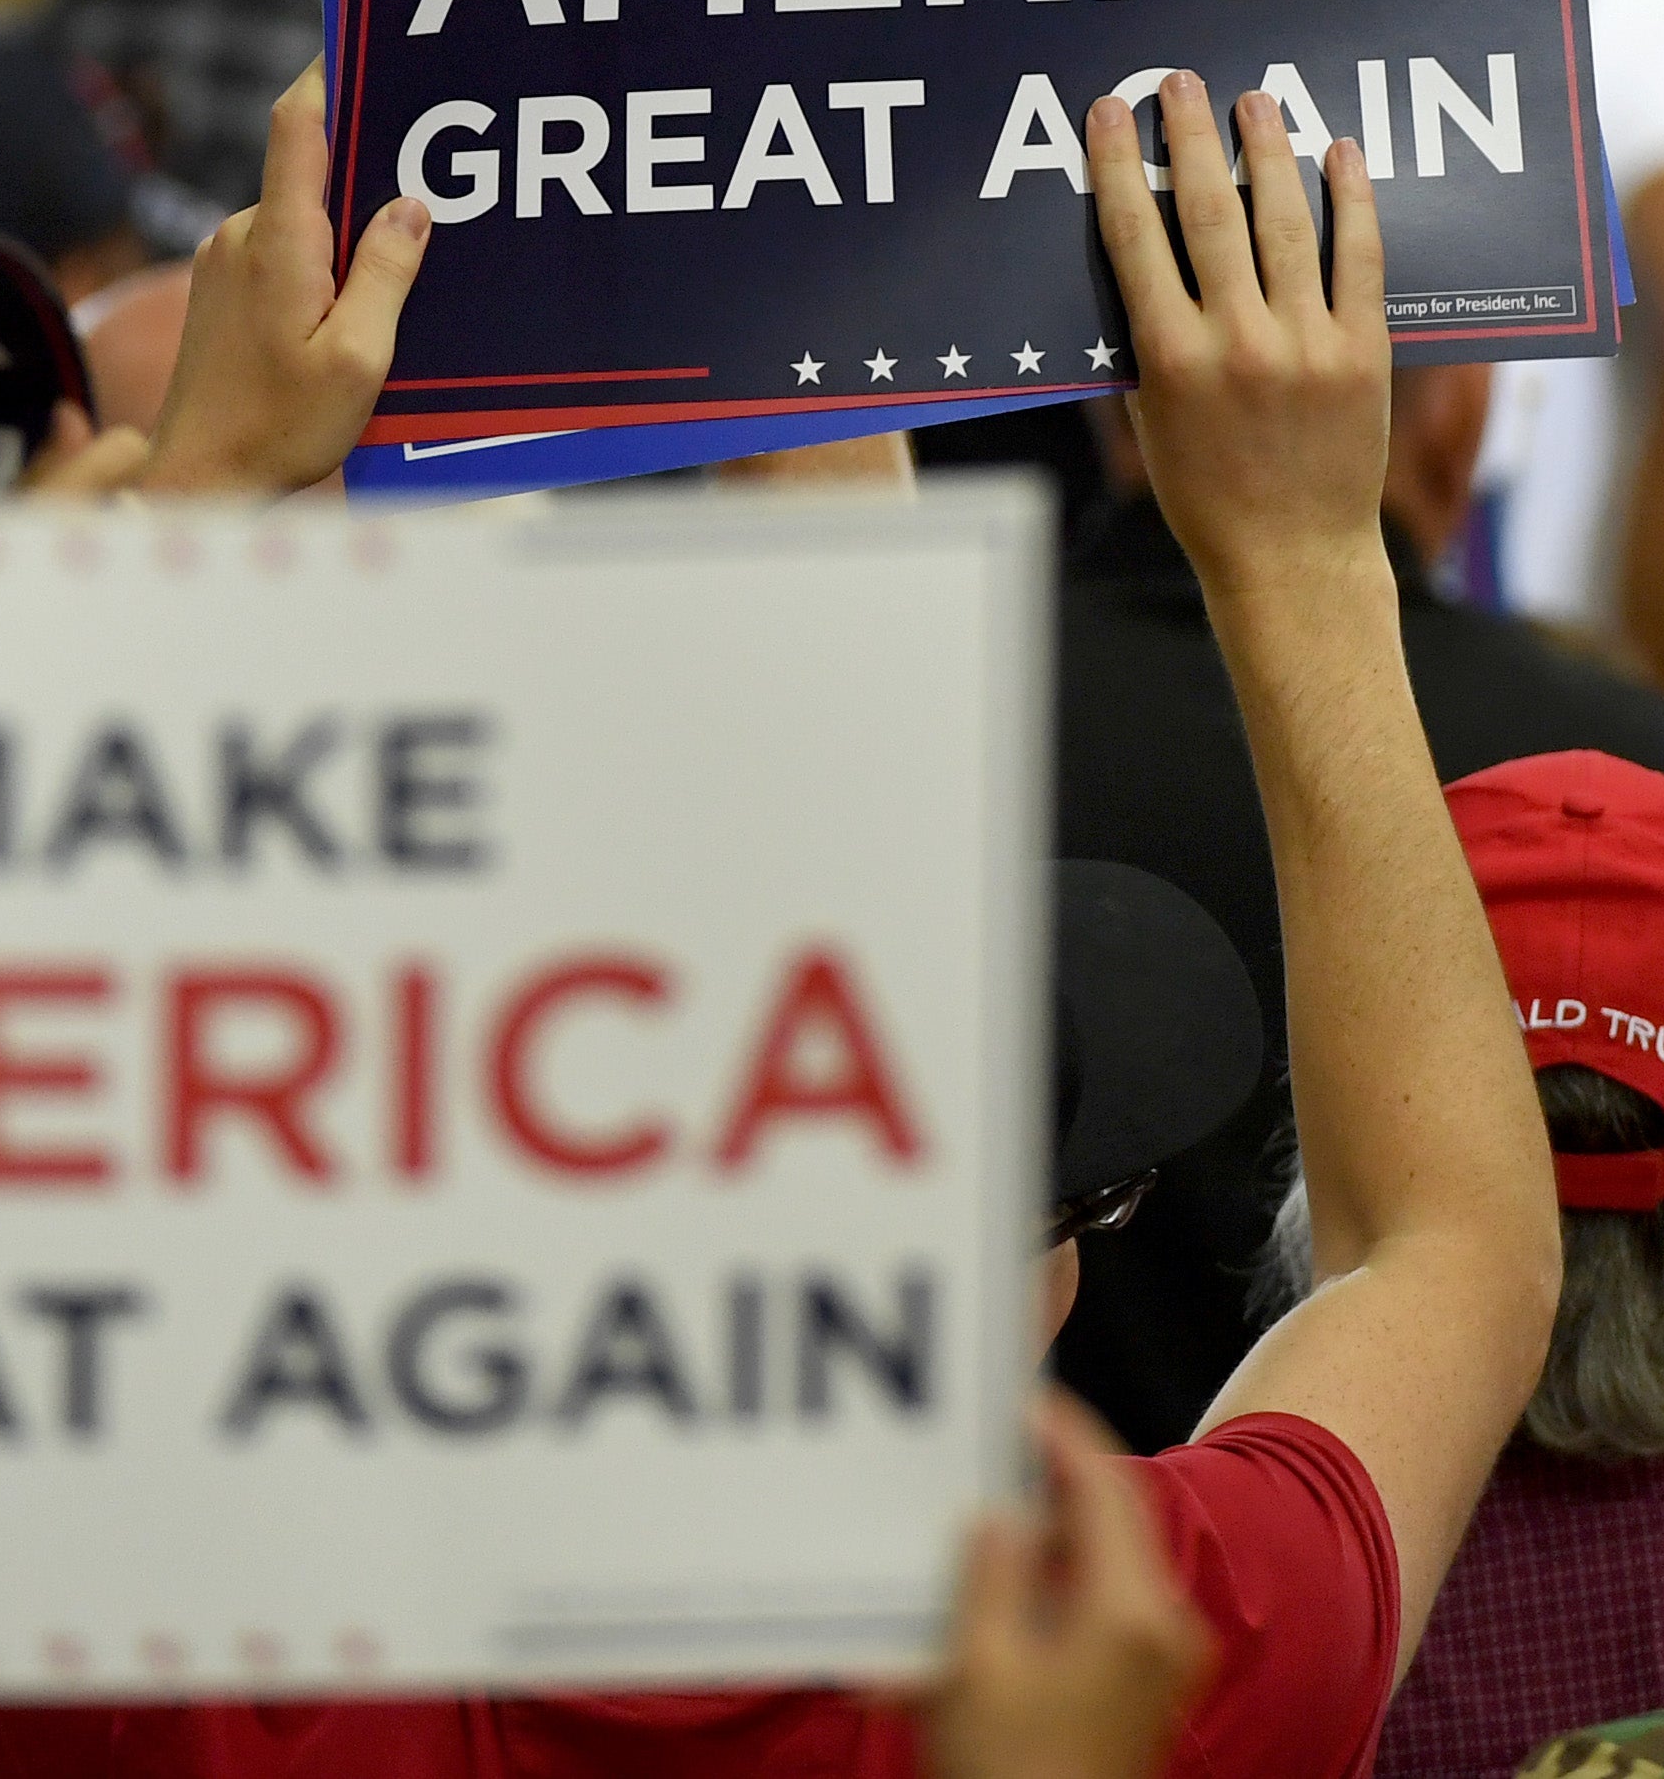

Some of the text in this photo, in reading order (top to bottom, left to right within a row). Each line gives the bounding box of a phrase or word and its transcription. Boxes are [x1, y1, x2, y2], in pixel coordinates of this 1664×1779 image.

[396, 79, 926, 225] GREAT
[1383, 294, 1561, 317] rump for President, Inc.
[220, 1264, 943, 1449] AGAIN
